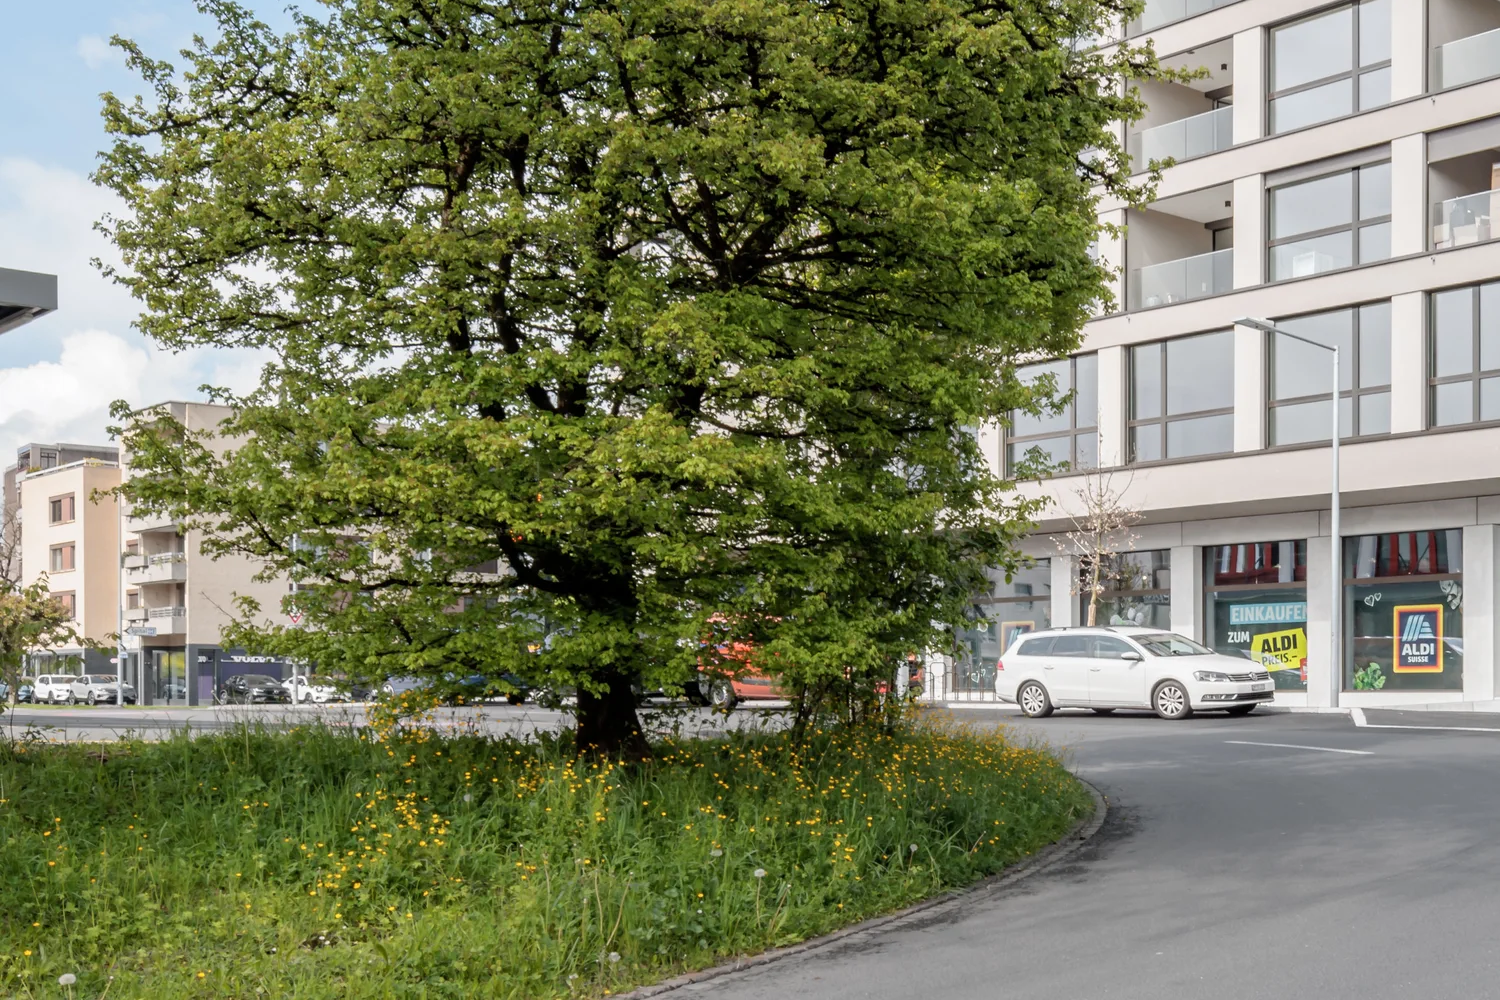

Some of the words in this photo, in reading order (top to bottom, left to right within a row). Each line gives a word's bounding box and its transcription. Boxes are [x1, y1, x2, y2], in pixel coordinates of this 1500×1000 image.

[1227, 631, 1250, 643] ZUM
[1261, 634, 1298, 653] ALDI
[1401, 643, 1435, 656] ALDI
[1407, 655, 1429, 663] SUISSE
